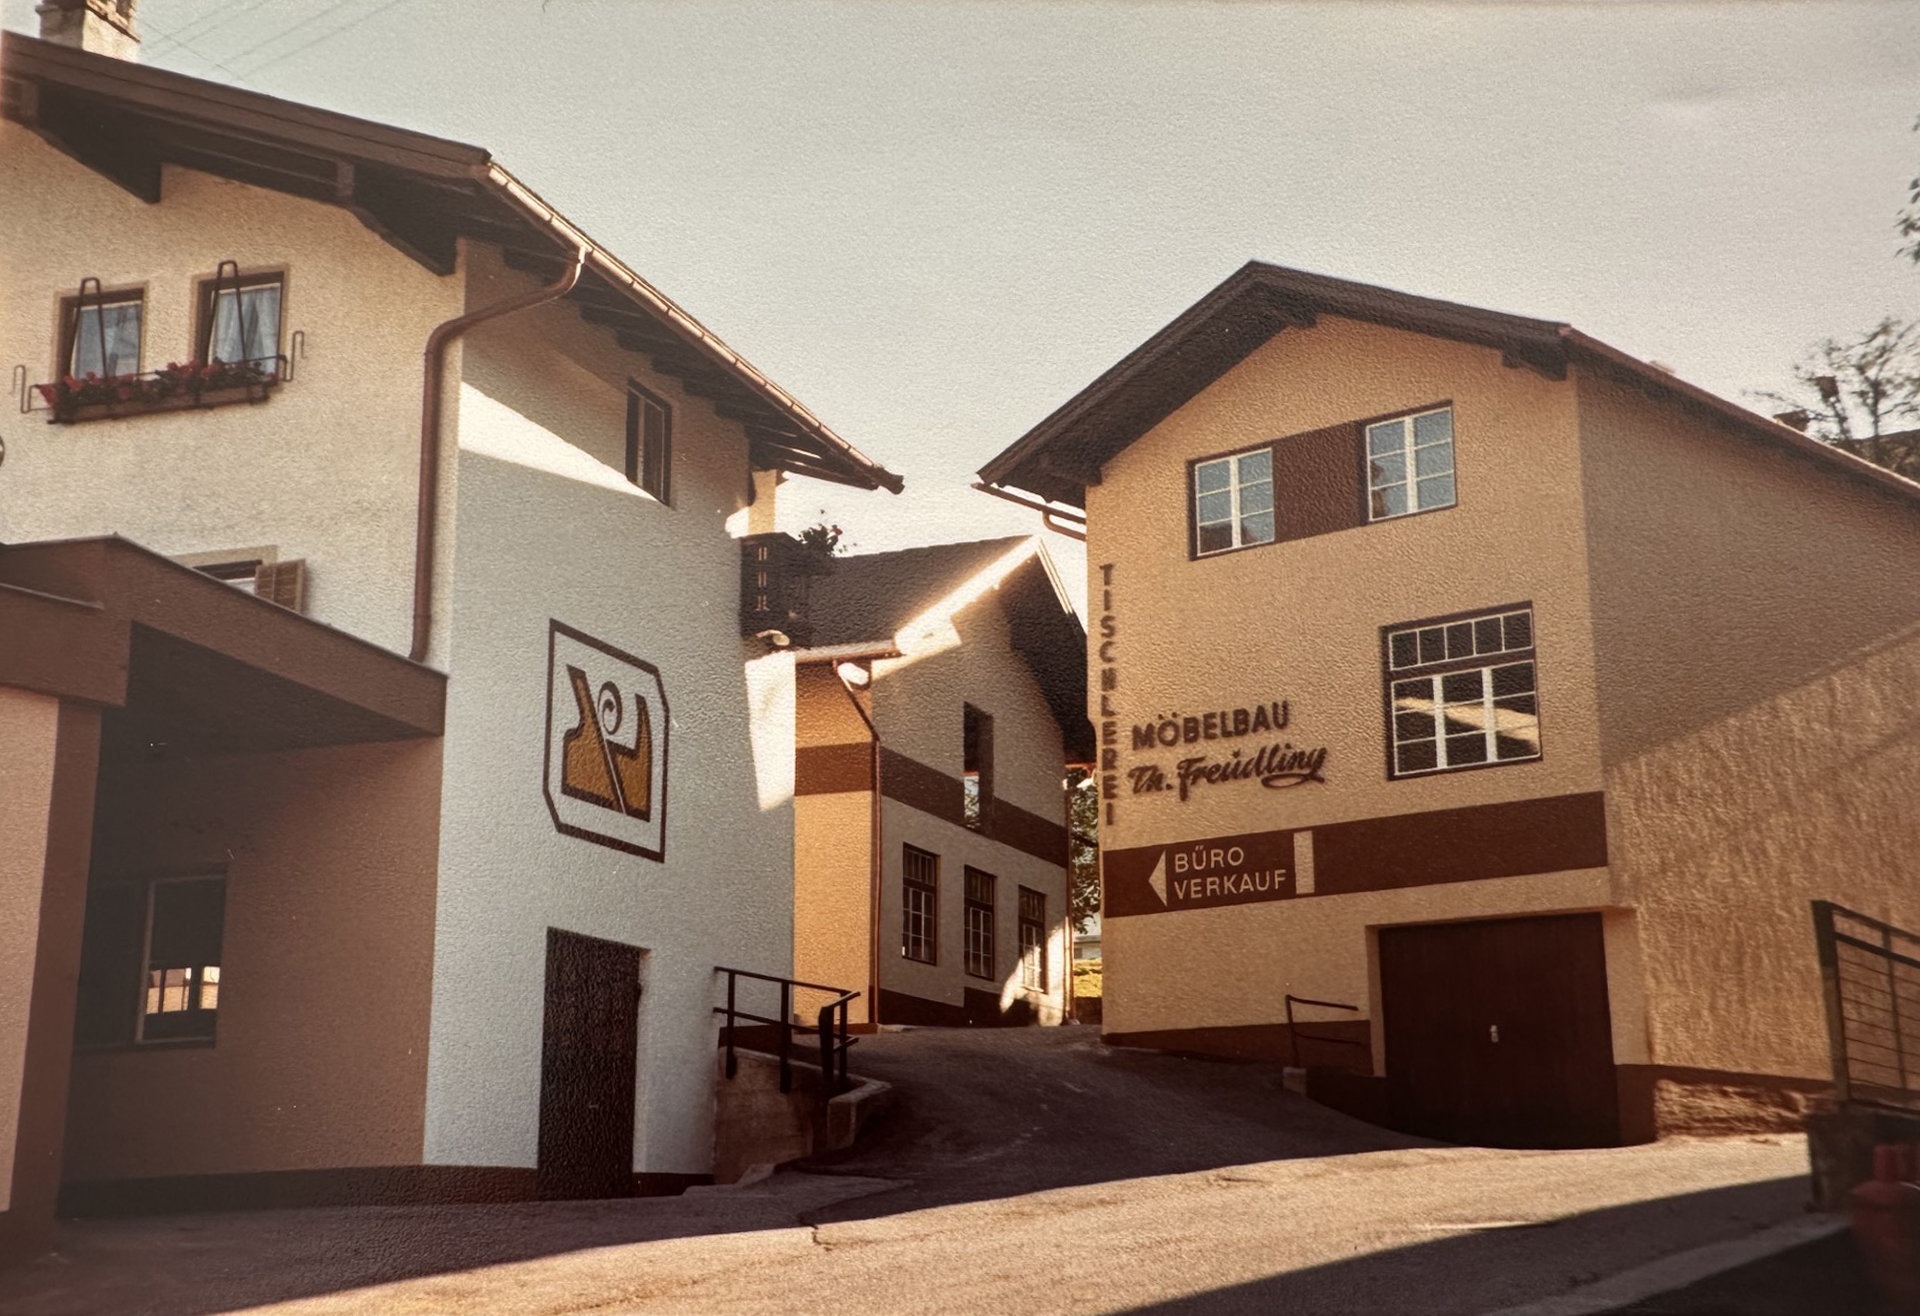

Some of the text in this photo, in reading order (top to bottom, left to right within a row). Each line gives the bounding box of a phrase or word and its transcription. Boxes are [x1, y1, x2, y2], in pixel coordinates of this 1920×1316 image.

[1099, 563, 1118, 826] TISCHLEREI
[1132, 700, 1289, 750] MÖBELBAU
[1174, 845, 1244, 873] BÜRO
[1174, 869, 1287, 899] VERKAUF
